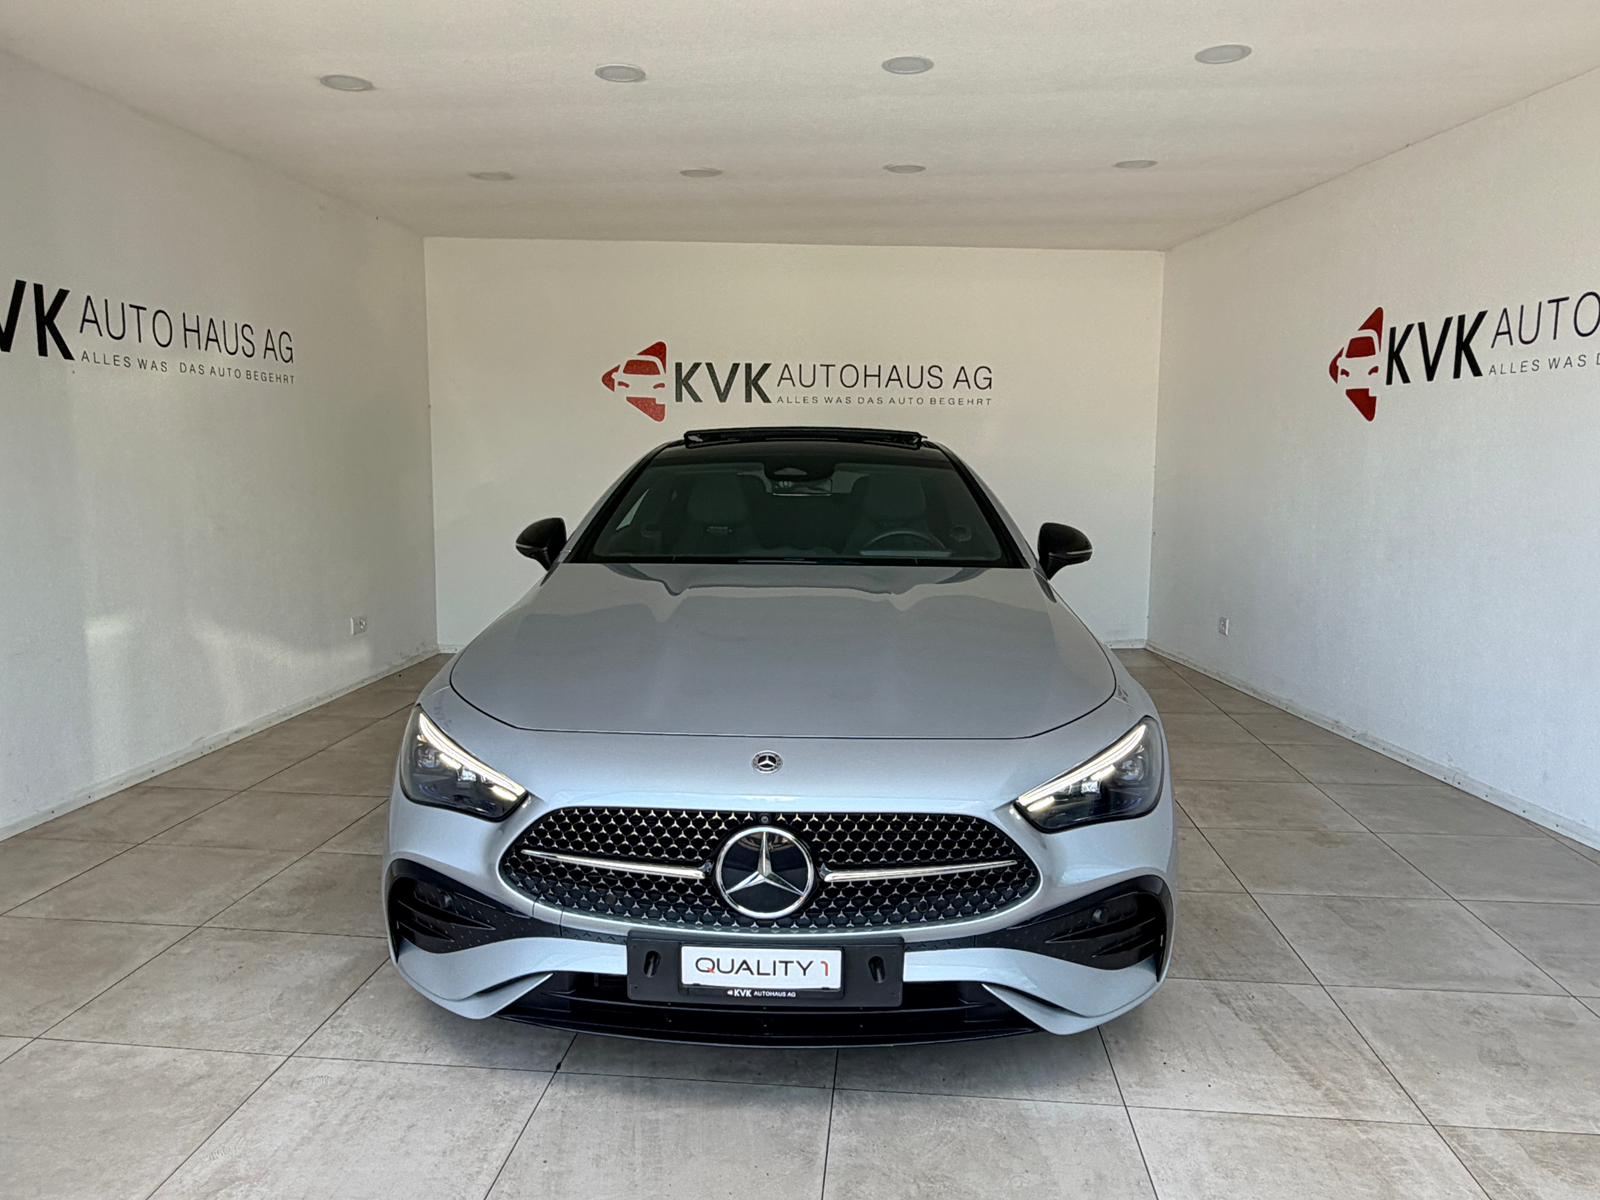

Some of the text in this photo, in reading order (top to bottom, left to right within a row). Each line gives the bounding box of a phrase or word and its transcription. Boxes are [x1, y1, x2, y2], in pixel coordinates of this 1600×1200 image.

[263, 328, 294, 364] AG
[1386, 310, 1488, 386] KVK
[81, 350, 295, 385] ALLES WAS DAS AUTO BEGEHRT
[1489, 358, 1540, 376] ALLES
[1548, 354, 1587, 370] WAS
[675, 361, 993, 403] KVK AUTOHAUS AG
[776, 395, 992, 406] ALLES WAS DAS AUTO BEGEHRT
[695, 957, 830, 977] QUALITY 1
[734, 988, 752, 998] KVK
[753, 990, 786, 998] AUTOHAUS
